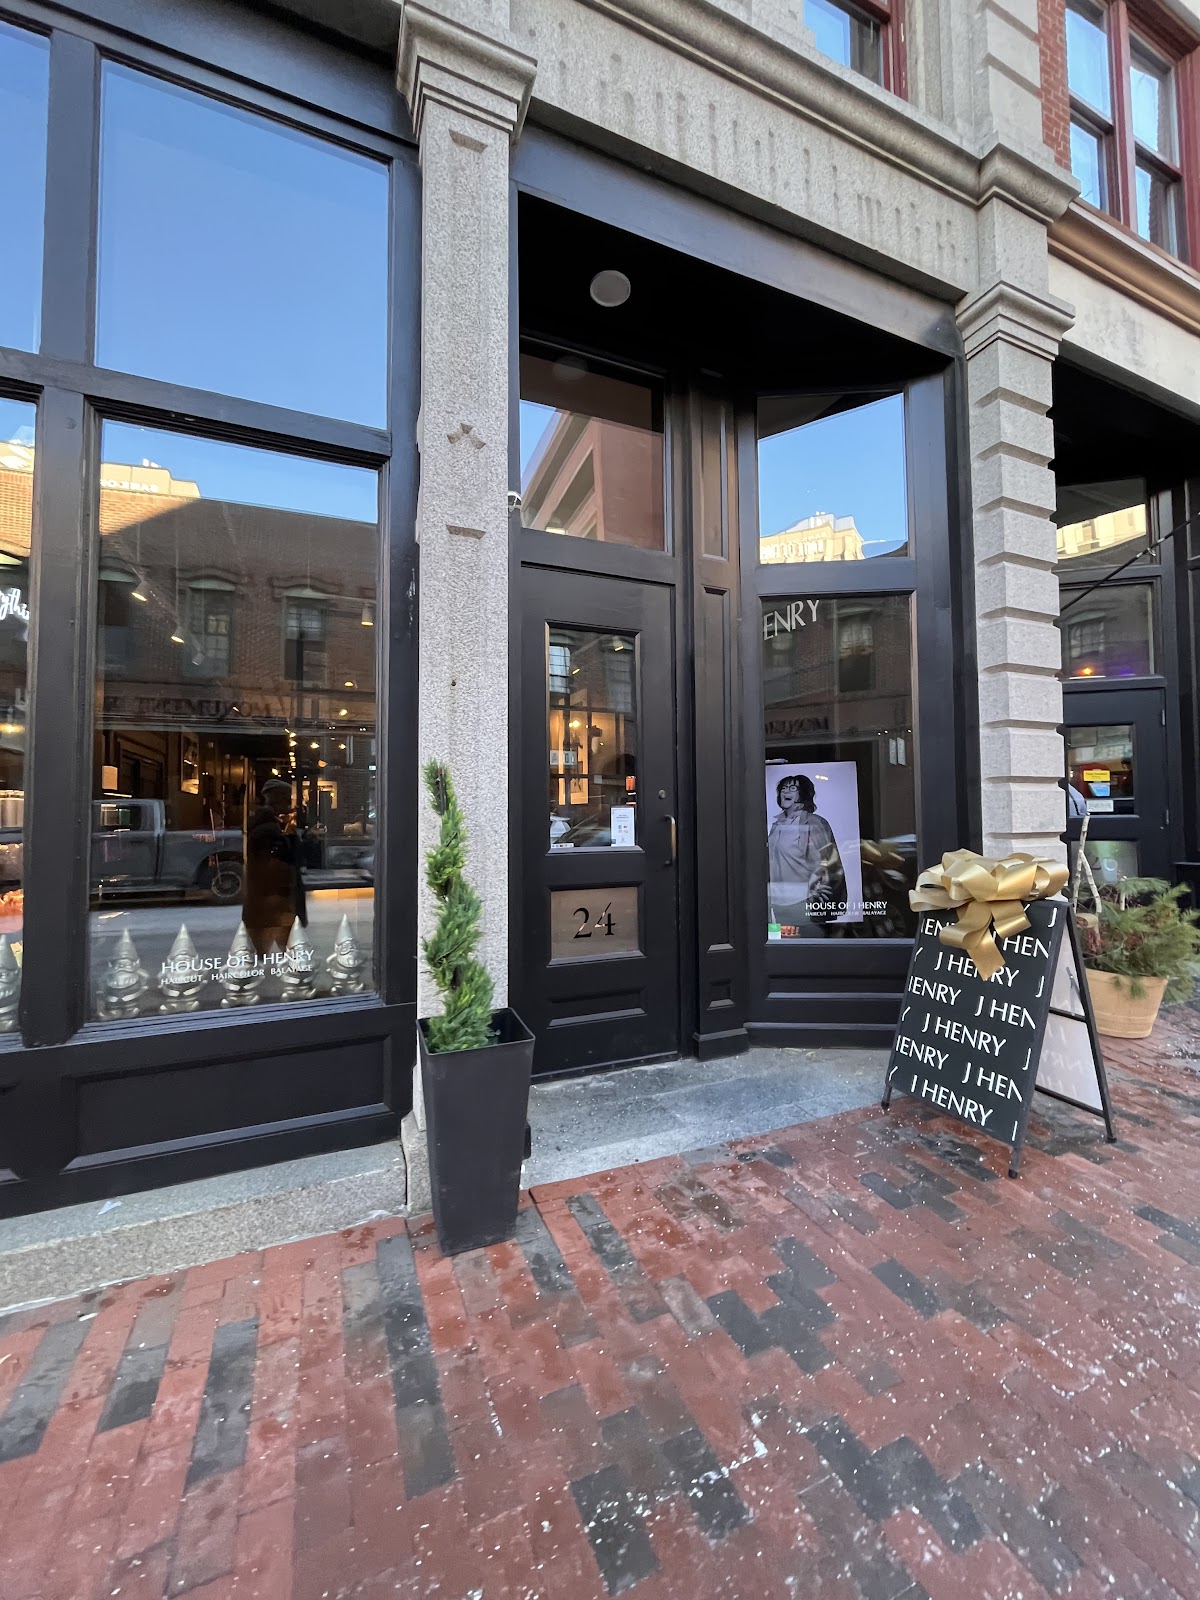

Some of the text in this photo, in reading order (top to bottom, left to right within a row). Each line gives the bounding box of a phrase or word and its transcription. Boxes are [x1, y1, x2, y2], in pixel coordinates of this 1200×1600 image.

[805, 901, 836, 910] HOUSE
[858, 901, 888, 910] HENRY
[573, 902, 616, 939] 24
[161, 949, 315, 975] HOUSE OF J HENRY
[934, 951, 944, 971] J
[947, 954, 1020, 988] HERY
[161, 974, 203, 985] HAIRCUT
[211, 969, 265, 981] HAIRCOLOR
[974, 995, 985, 1017] J
[921, 1012, 931, 1033] J
[934, 1016, 1007, 1057] HENRY
[961, 1062, 972, 1084] J
[921, 1079, 994, 1127] HENRY
